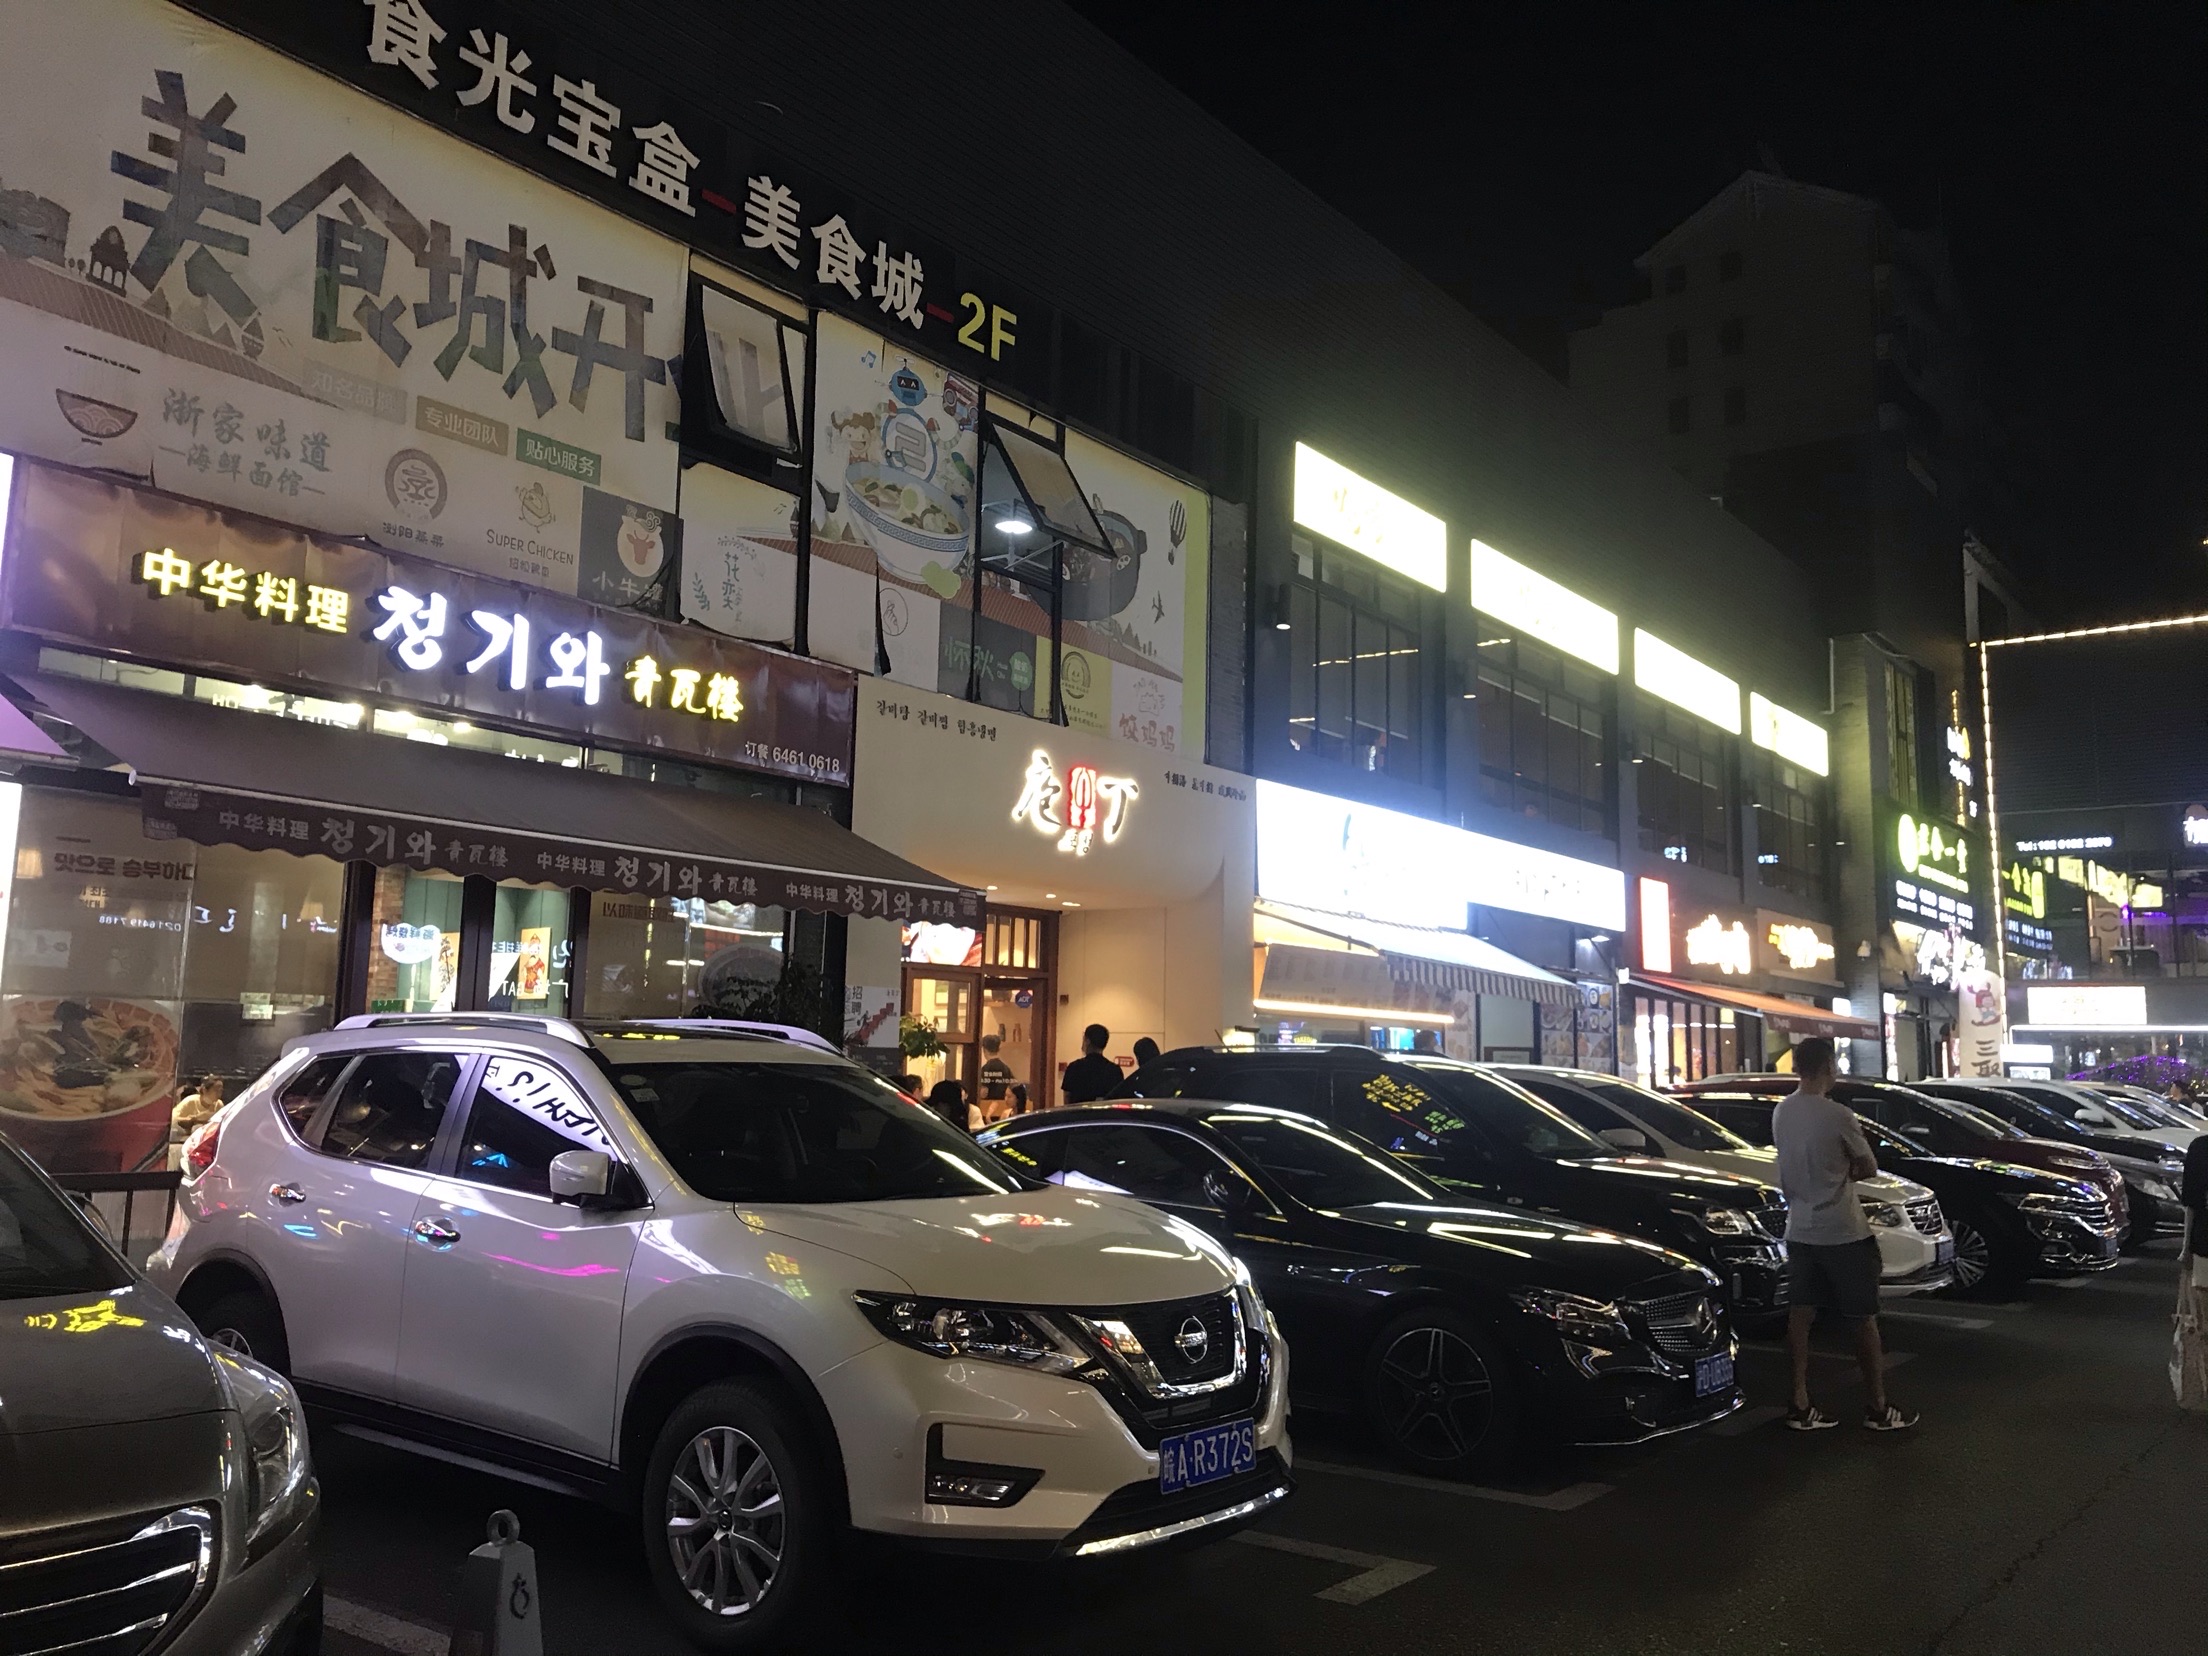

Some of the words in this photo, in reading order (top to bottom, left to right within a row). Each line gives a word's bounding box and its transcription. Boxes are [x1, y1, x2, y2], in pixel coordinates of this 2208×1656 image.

[424, 405, 499, 448] 专业团队
[525, 437, 596, 477] 贴心服务
[486, 529, 524, 553] SUPER
[527, 540, 574, 566] CHICKEN
[141, 547, 350, 635] 中华料理
[745, 741, 769, 760] 订餐
[772, 746, 804, 767] 6461
[808, 753, 840, 773] 0618
[54, 852, 116, 876] 맛으로
[219, 807, 309, 841] 中华料理
[537, 851, 606, 877] 中华料理
[786, 882, 839, 903] 中华料理
